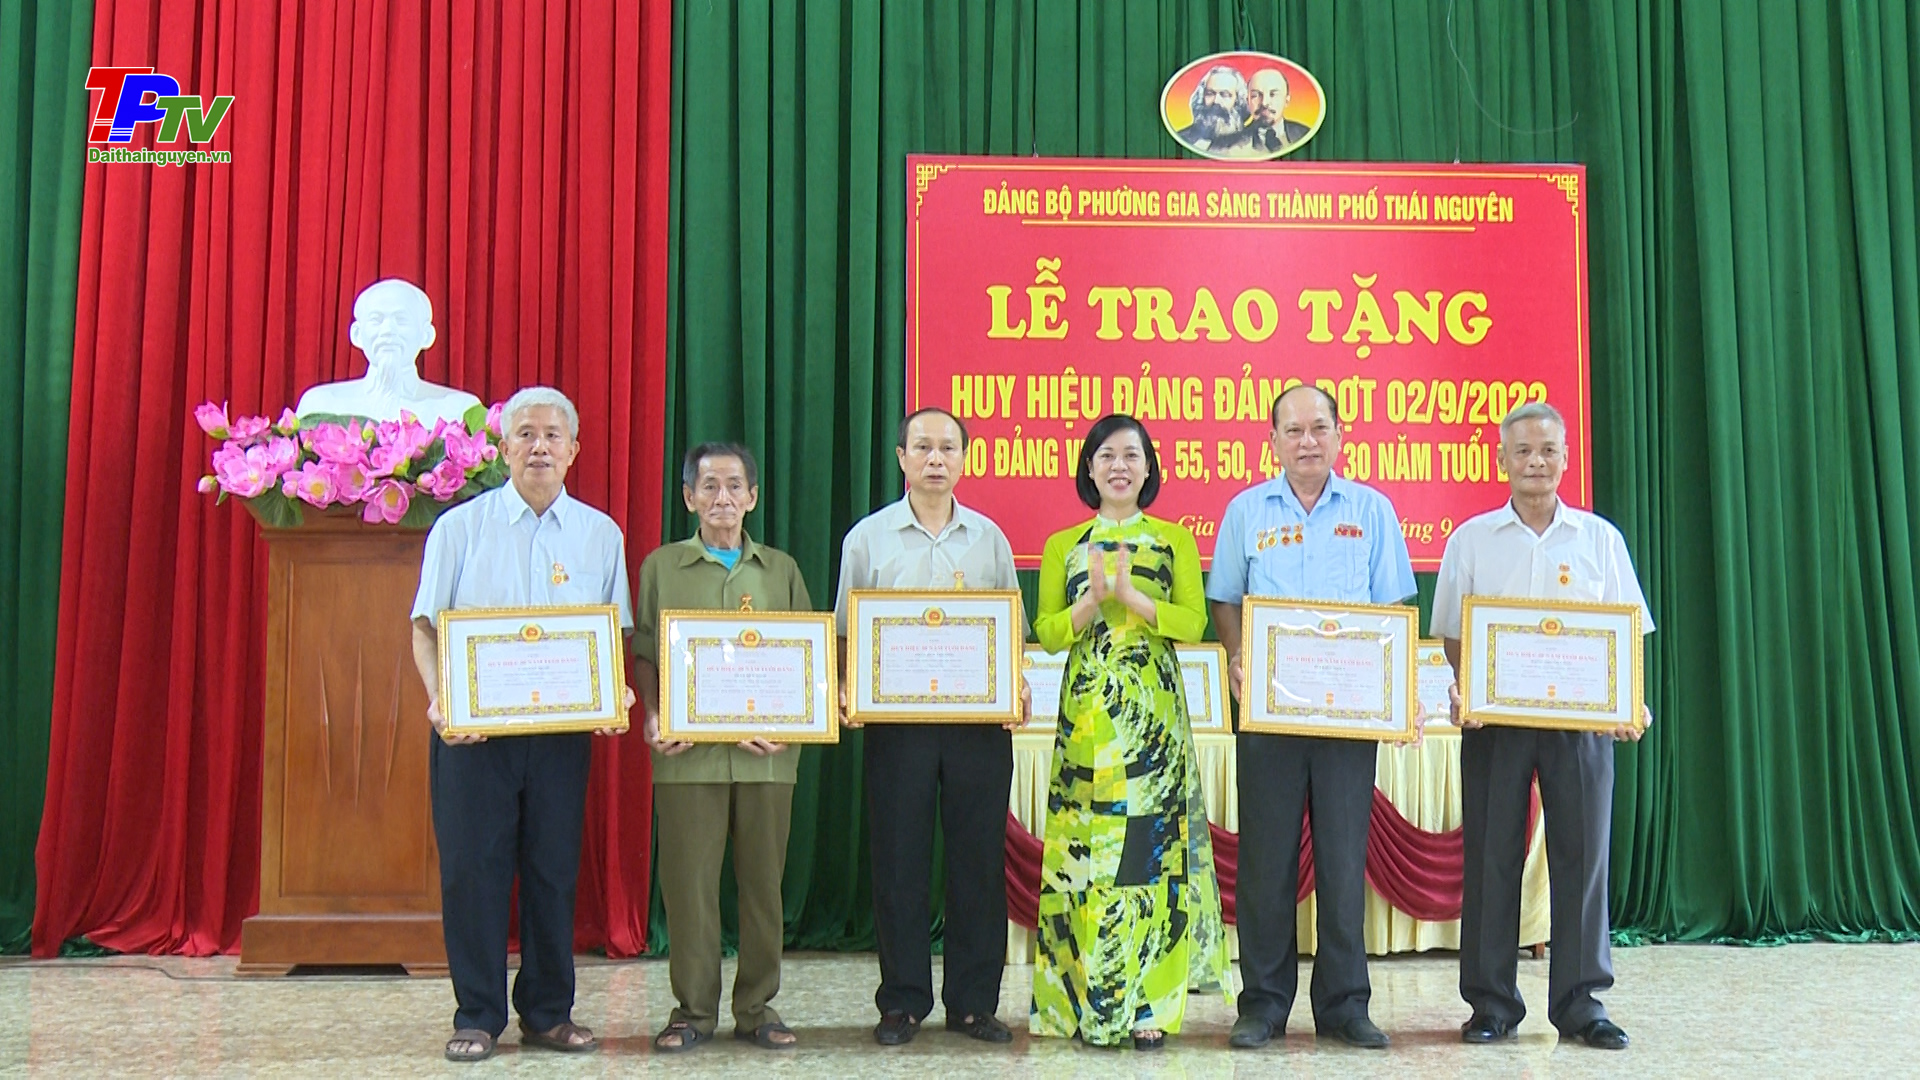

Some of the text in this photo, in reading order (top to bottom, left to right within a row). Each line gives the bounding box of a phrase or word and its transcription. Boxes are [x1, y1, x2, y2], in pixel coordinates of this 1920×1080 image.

[983, 180, 1514, 223] ĐẢNG BỘ PHƯỜNG GIA SÀNG THÀNH PHỐ THÁI NGUYÊN
[986, 256, 1493, 359] LỄ TRAO TẶNG
[951, 374, 1016, 419] HUY
[1027, 366, 1102, 430] HIỆU
[1112, 362, 1203, 421] ĐẢNG
[1213, 362, 1303, 421] ĐẢN
[994, 424, 1058, 478] ĐẢNG
[1175, 440, 1210, 484] 55,
[1217, 440, 1252, 484] 50,
[1343, 441, 1371, 481] 30
[1378, 433, 1432, 482] NĂM
[1438, 427, 1490, 482] TUỔI
[1178, 514, 1453, 544] Gia áng 9
